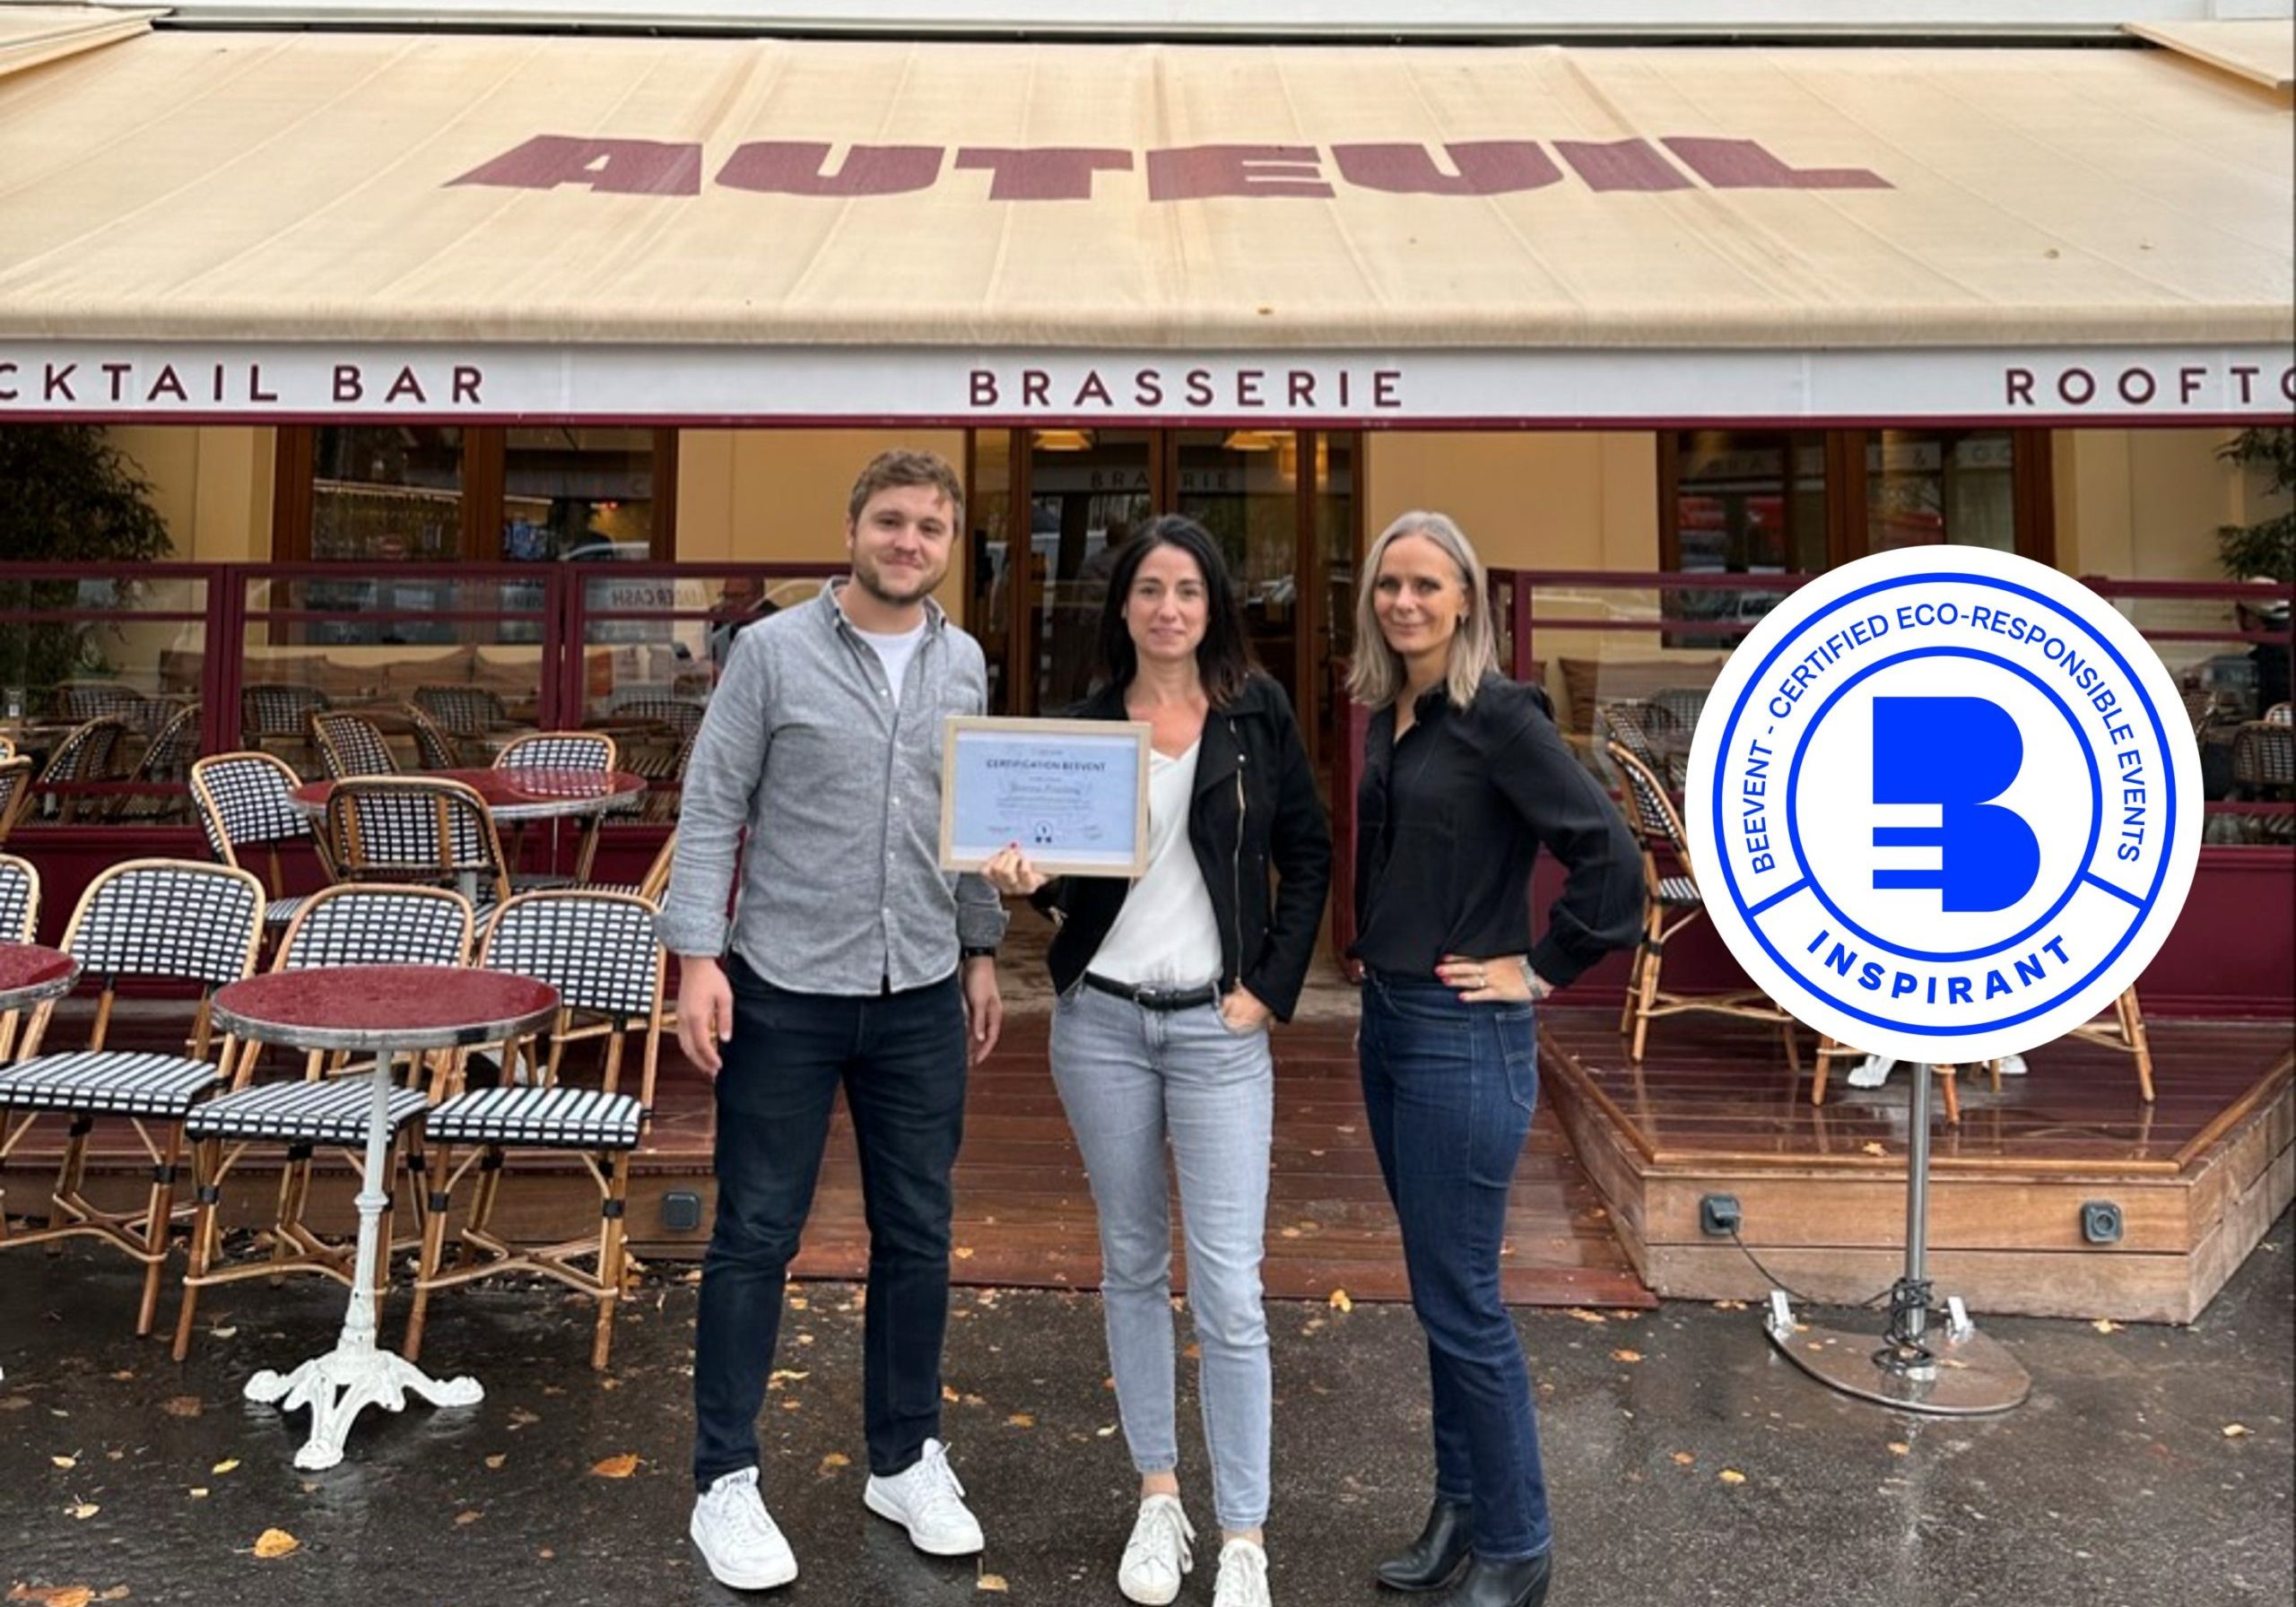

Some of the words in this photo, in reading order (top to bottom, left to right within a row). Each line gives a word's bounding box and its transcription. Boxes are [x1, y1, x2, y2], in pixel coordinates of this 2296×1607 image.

[442, 135, 1897, 201] AUTEUIL
[333, 364, 483, 404] BAR
[970, 369, 1402, 408] BRASSERIE
